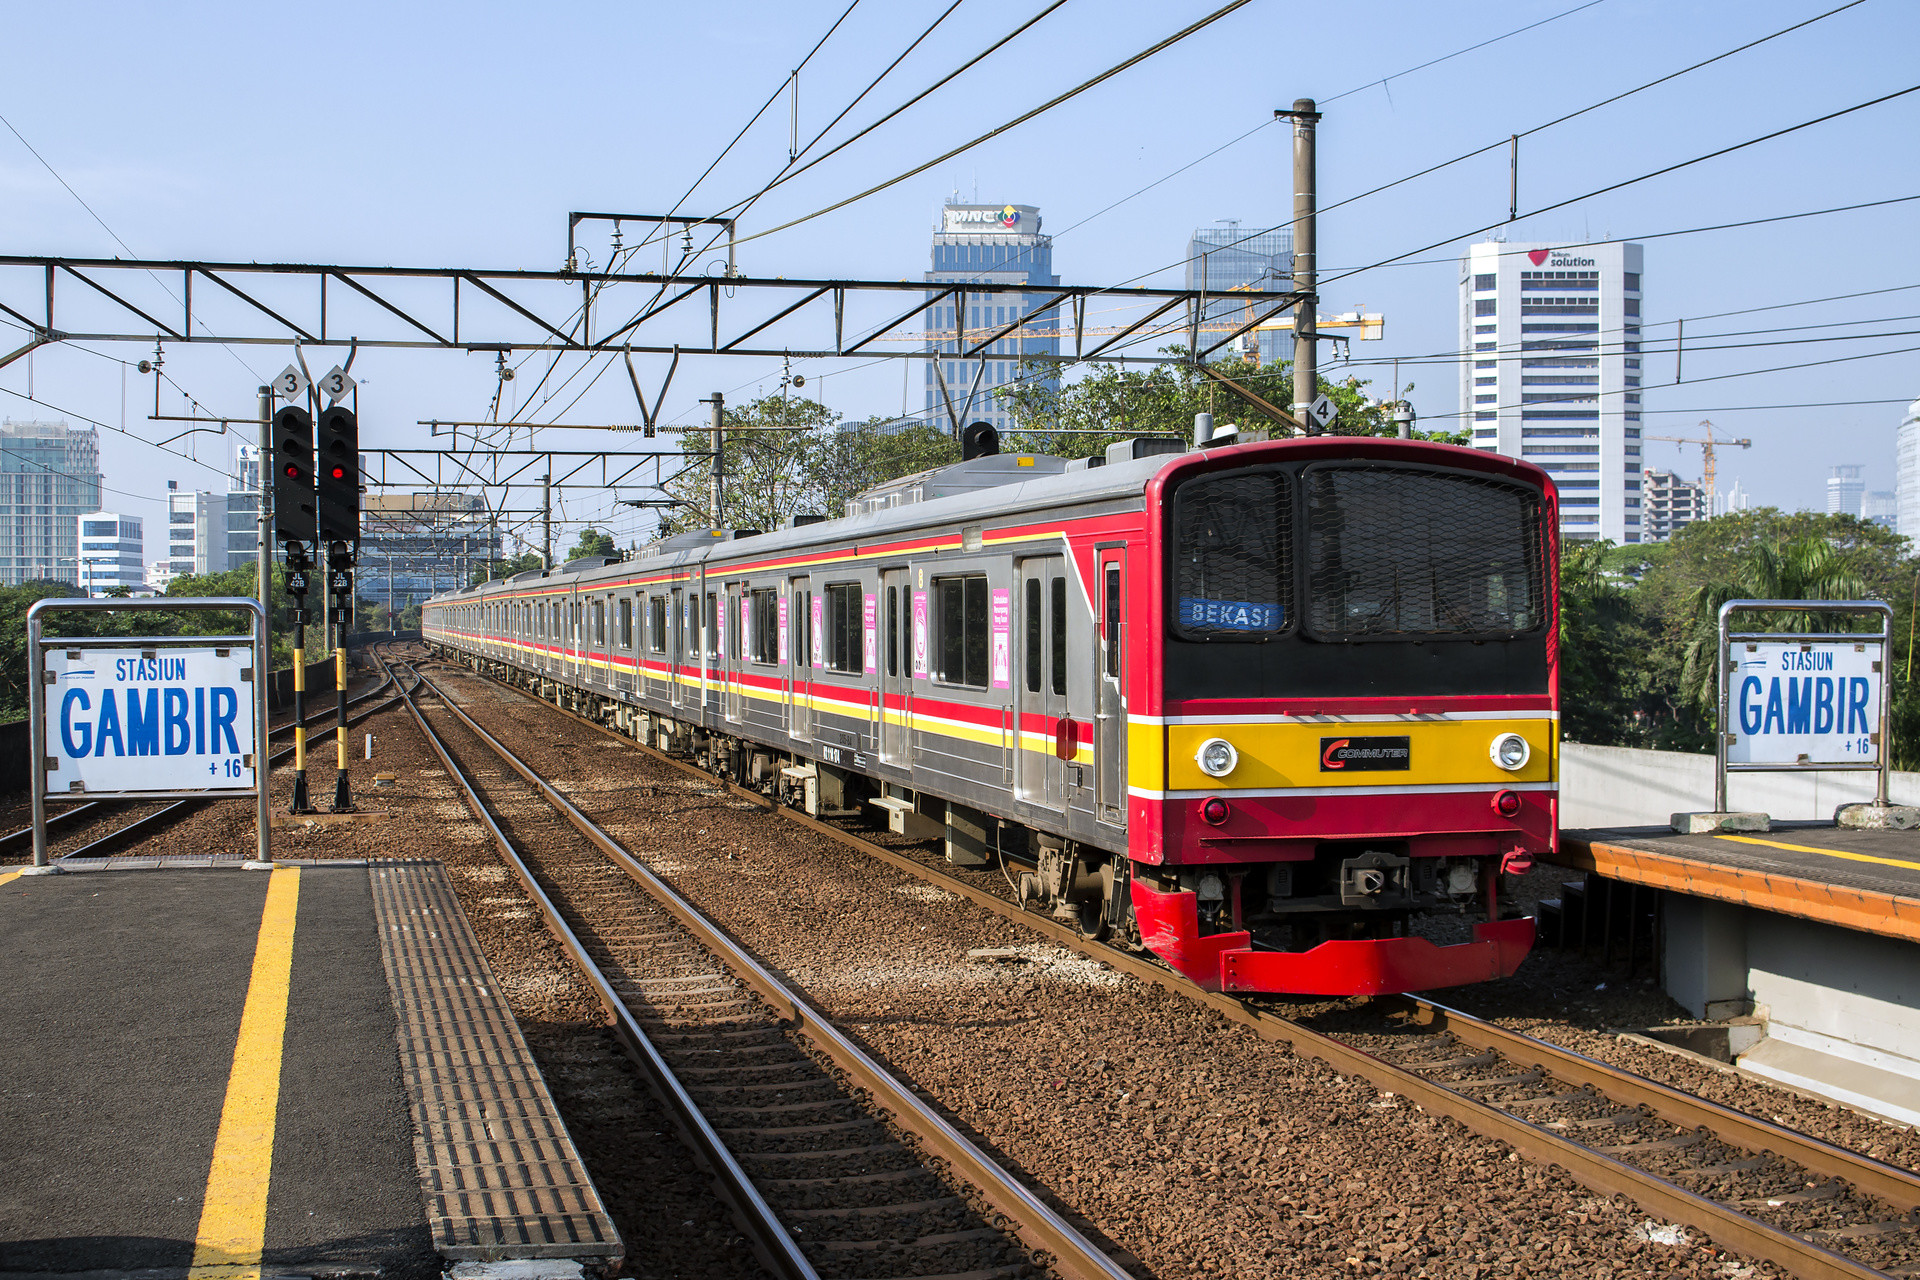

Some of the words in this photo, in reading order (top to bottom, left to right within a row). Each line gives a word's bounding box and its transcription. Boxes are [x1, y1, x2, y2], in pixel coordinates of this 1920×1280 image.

[1551, 257, 1595, 267] solution
[284, 373, 298, 393] 3
[330, 374, 344, 394] 3
[1316, 400, 1329, 419] 4
[1192, 604, 1270, 627] BEKASI
[116, 658, 186, 681] STASIUN
[1781, 651, 1833, 671] STASIUN
[1739, 675, 1869, 735] GAMBIR
[60, 687, 241, 759] GAMBIR
[1337, 748, 1409, 759] COMMUTER
